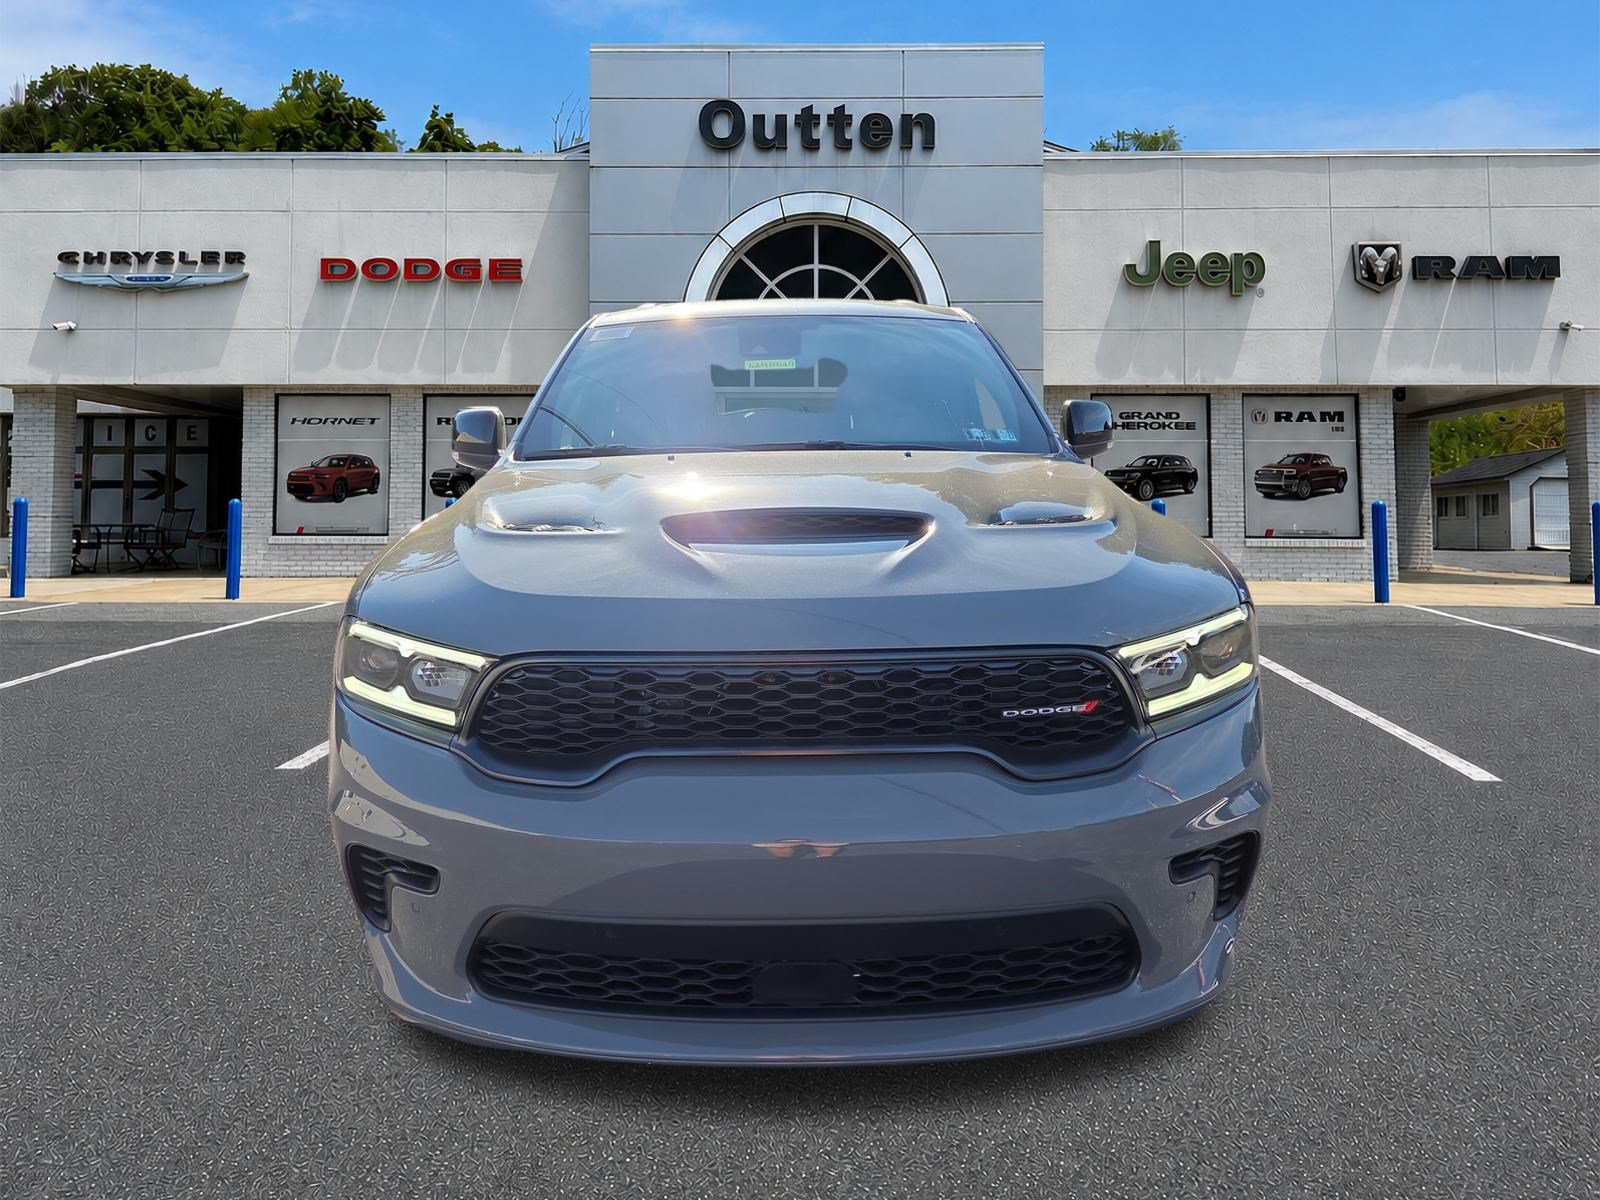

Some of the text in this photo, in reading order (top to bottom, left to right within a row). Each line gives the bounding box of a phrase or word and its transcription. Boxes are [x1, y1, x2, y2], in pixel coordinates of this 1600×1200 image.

[699, 99, 936, 150] Outten
[57, 251, 247, 266] CHRYSLER
[320, 257, 523, 282] DODGE
[1123, 239, 1266, 297] Jeep
[1411, 255, 1561, 280] RAM
[290, 417, 381, 426] HORNET
[1118, 411, 1181, 420] GRAND
[1274, 411, 1345, 423] RAM
[1113, 421, 1197, 431] HEROKEE
[1003, 704, 1087, 717] DODGE
